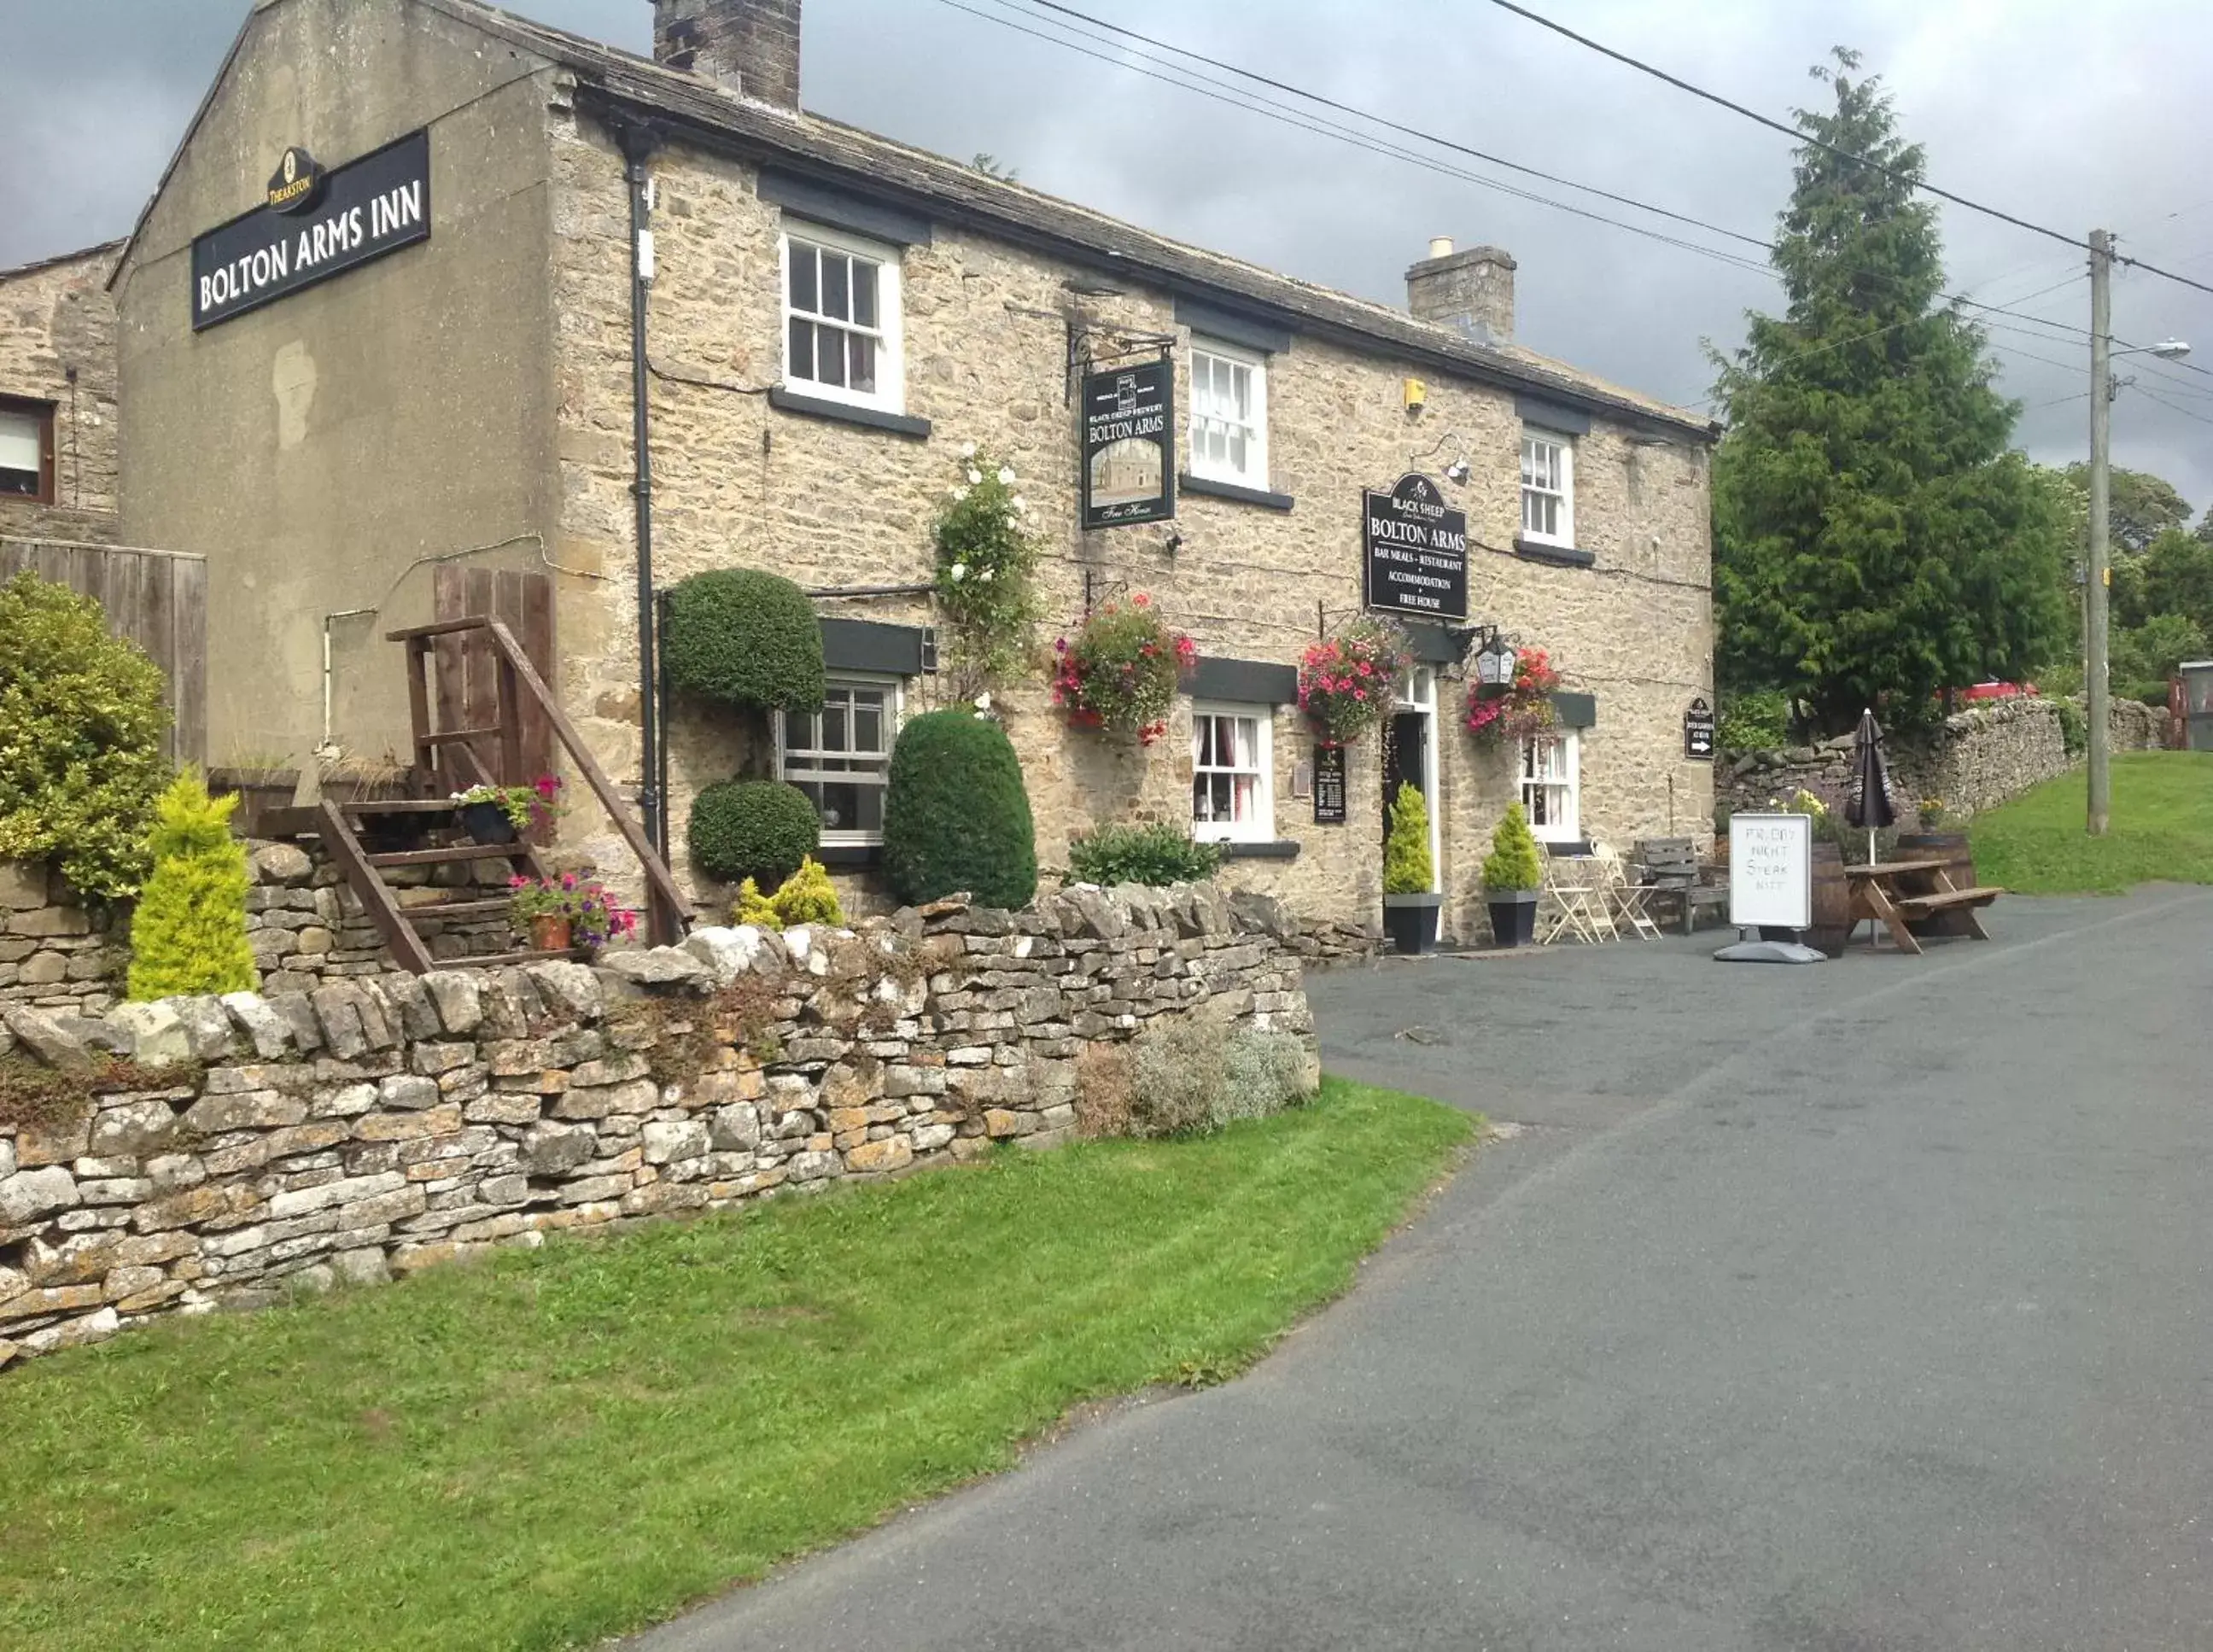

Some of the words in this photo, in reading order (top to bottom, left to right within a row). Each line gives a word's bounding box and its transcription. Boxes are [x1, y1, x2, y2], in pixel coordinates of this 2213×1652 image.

[269, 175, 311, 205] THEAKSTON
[200, 240, 288, 311] BOLTON
[295, 207, 363, 271] ARMS
[371, 179, 421, 238] INN
[1089, 421, 1133, 443] BOLTON
[1135, 416, 1164, 435] ARMS
[1393, 497, 1419, 512] BLACK
[1420, 504, 1445, 518] SHEEP
[1371, 517, 1428, 544] BOLTON
[1430, 529, 1465, 552] ARMS
[1375, 547, 1389, 558] BAR
[1391, 549, 1414, 563] MEALS
[1419, 555, 1463, 571] RESTAURANT
[1388, 570, 1451, 590] ACCOMMODATION
[1400, 593, 1416, 604] FREE
[1417, 596, 1440, 609] HOUSE
